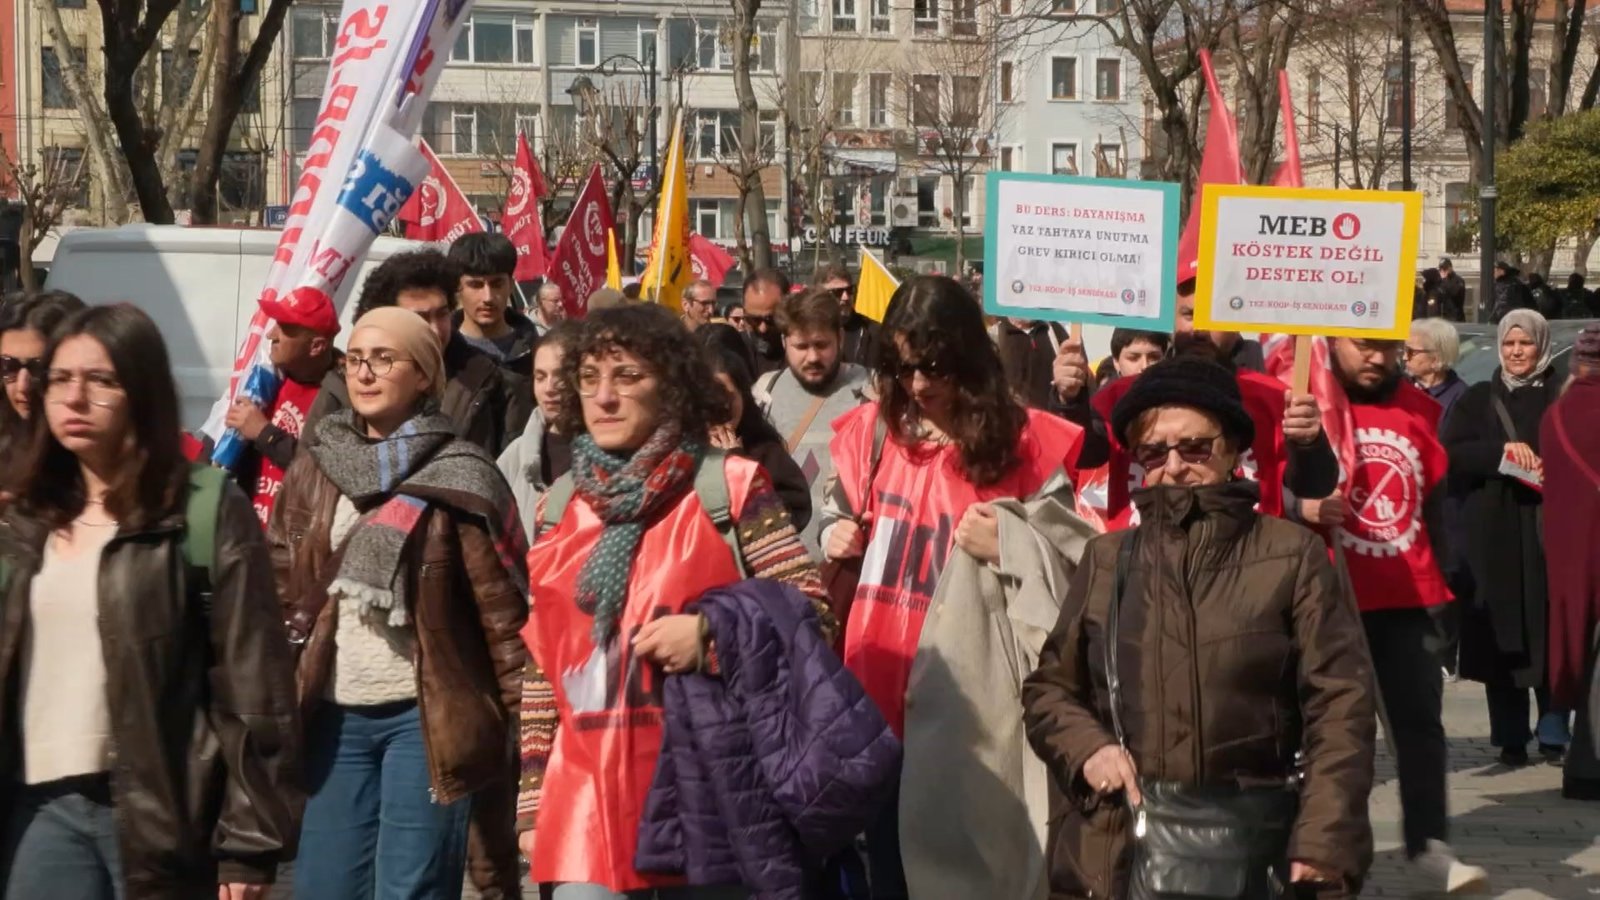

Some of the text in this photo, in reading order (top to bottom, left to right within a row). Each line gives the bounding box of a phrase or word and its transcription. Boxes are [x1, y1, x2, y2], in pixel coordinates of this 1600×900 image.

[1016, 204, 1145, 223] BU DERS: DAYANIŞMA
[1012, 225, 1149, 244] YAZ TAHTAYA UNUTMA
[1258, 214, 1327, 237] MEB
[805, 227, 890, 246] CIFFEUR
[1018, 247, 1141, 265] GREV KIRICI OLMA!
[1232, 241, 1384, 262] KÖSTEK DEĞİL
[1246, 267, 1365, 284] DESTEK OL!
